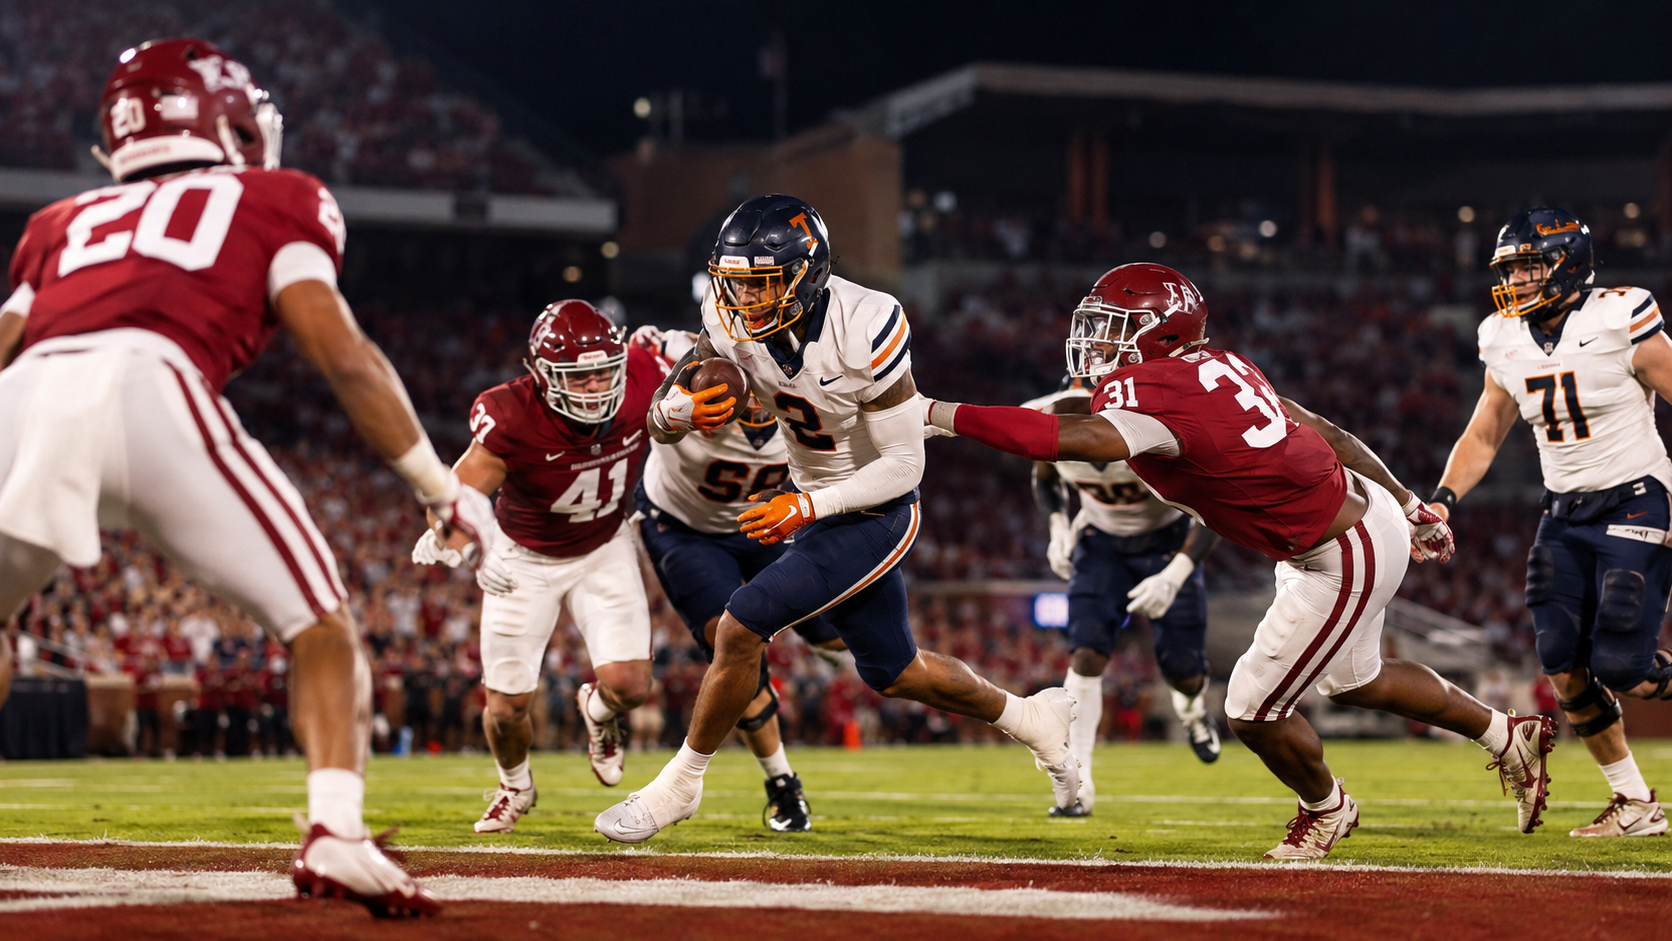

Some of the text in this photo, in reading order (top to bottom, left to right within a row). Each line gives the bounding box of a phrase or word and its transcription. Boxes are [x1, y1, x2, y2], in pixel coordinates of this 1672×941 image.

[110, 97, 146, 139] 20
[58, 172, 244, 277] 20
[789, 212, 819, 249] T
[1103, 376, 1139, 410] 31
[1525, 371, 1591, 442] 71
[469, 402, 496, 444] 37
[773, 390, 837, 452] 2
[550, 458, 628, 523] 41
